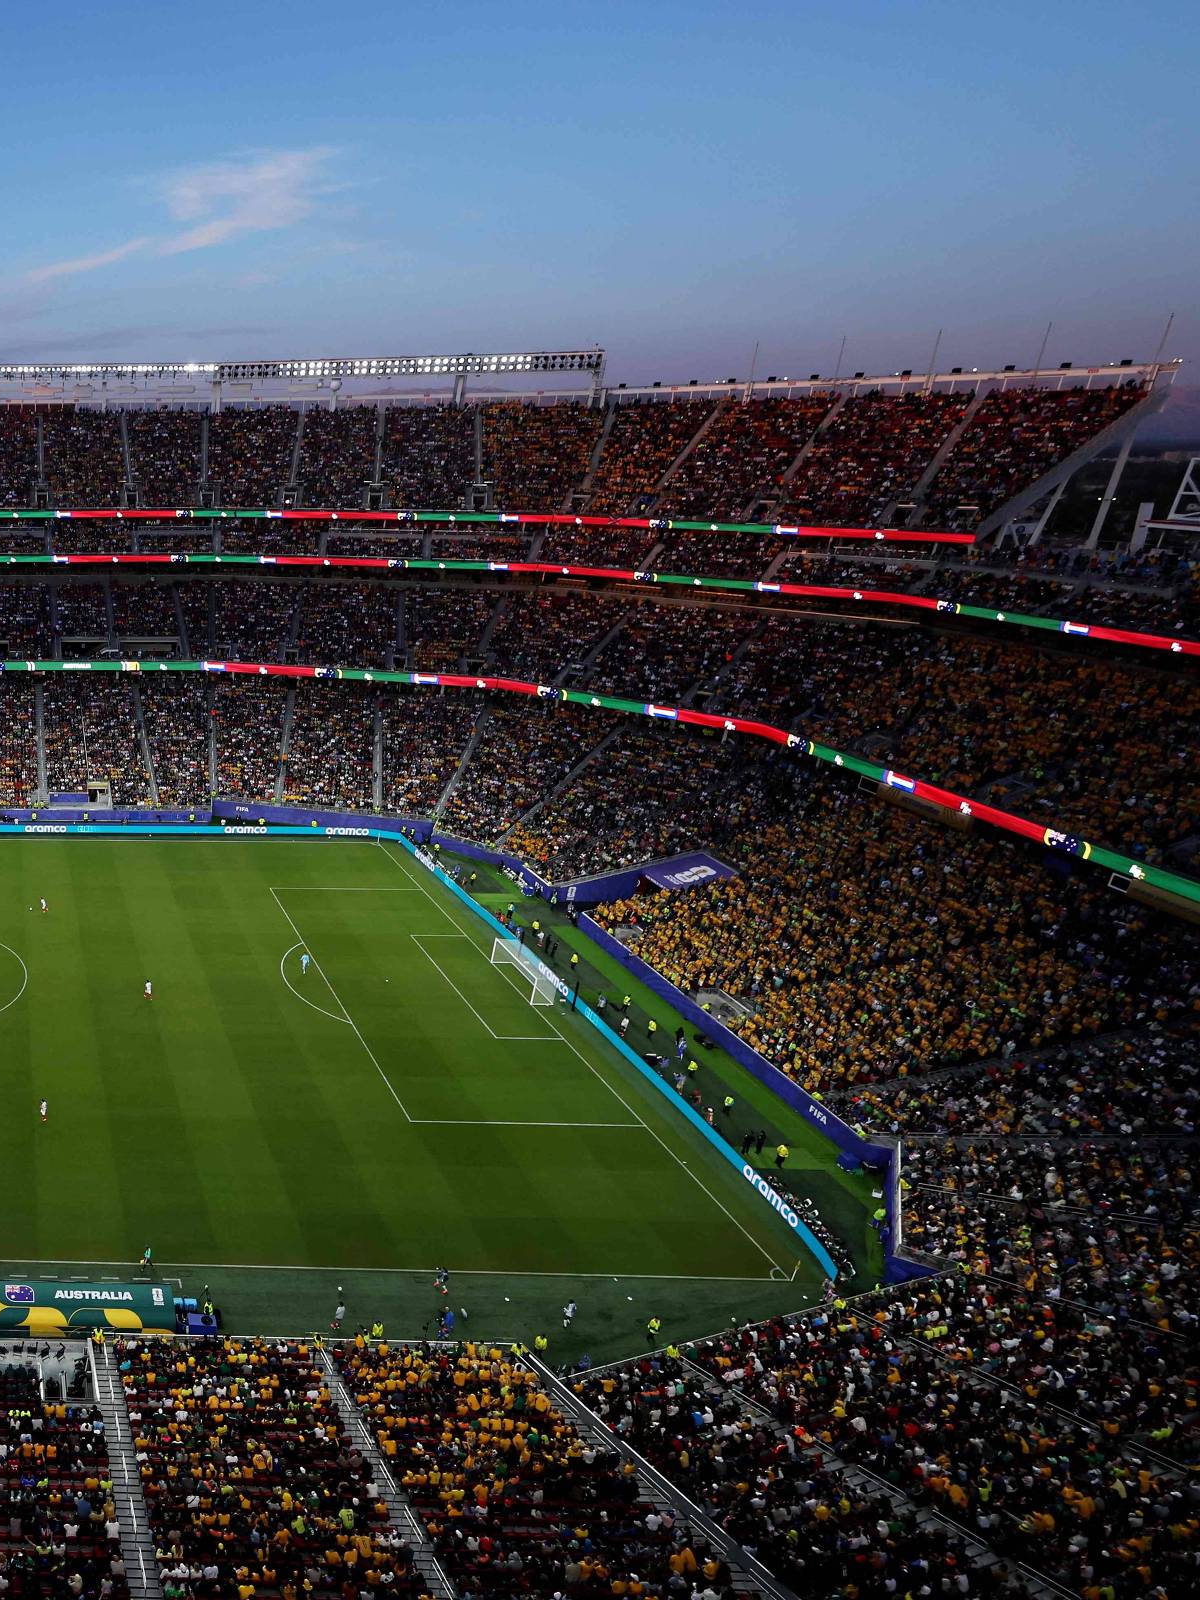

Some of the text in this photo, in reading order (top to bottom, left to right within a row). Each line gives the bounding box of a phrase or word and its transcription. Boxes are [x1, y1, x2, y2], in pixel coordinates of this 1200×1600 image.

[25, 825, 67, 833] aramco
[224, 826, 267, 834] aramco
[325, 827, 369, 836] aramco
[414, 850, 435, 872] aramco
[538, 962, 569, 997] aramco
[808, 1105, 827, 1125] FIFA
[742, 1164, 799, 1228] aramco
[54, 1289, 133, 1301] AUSTRALIA
